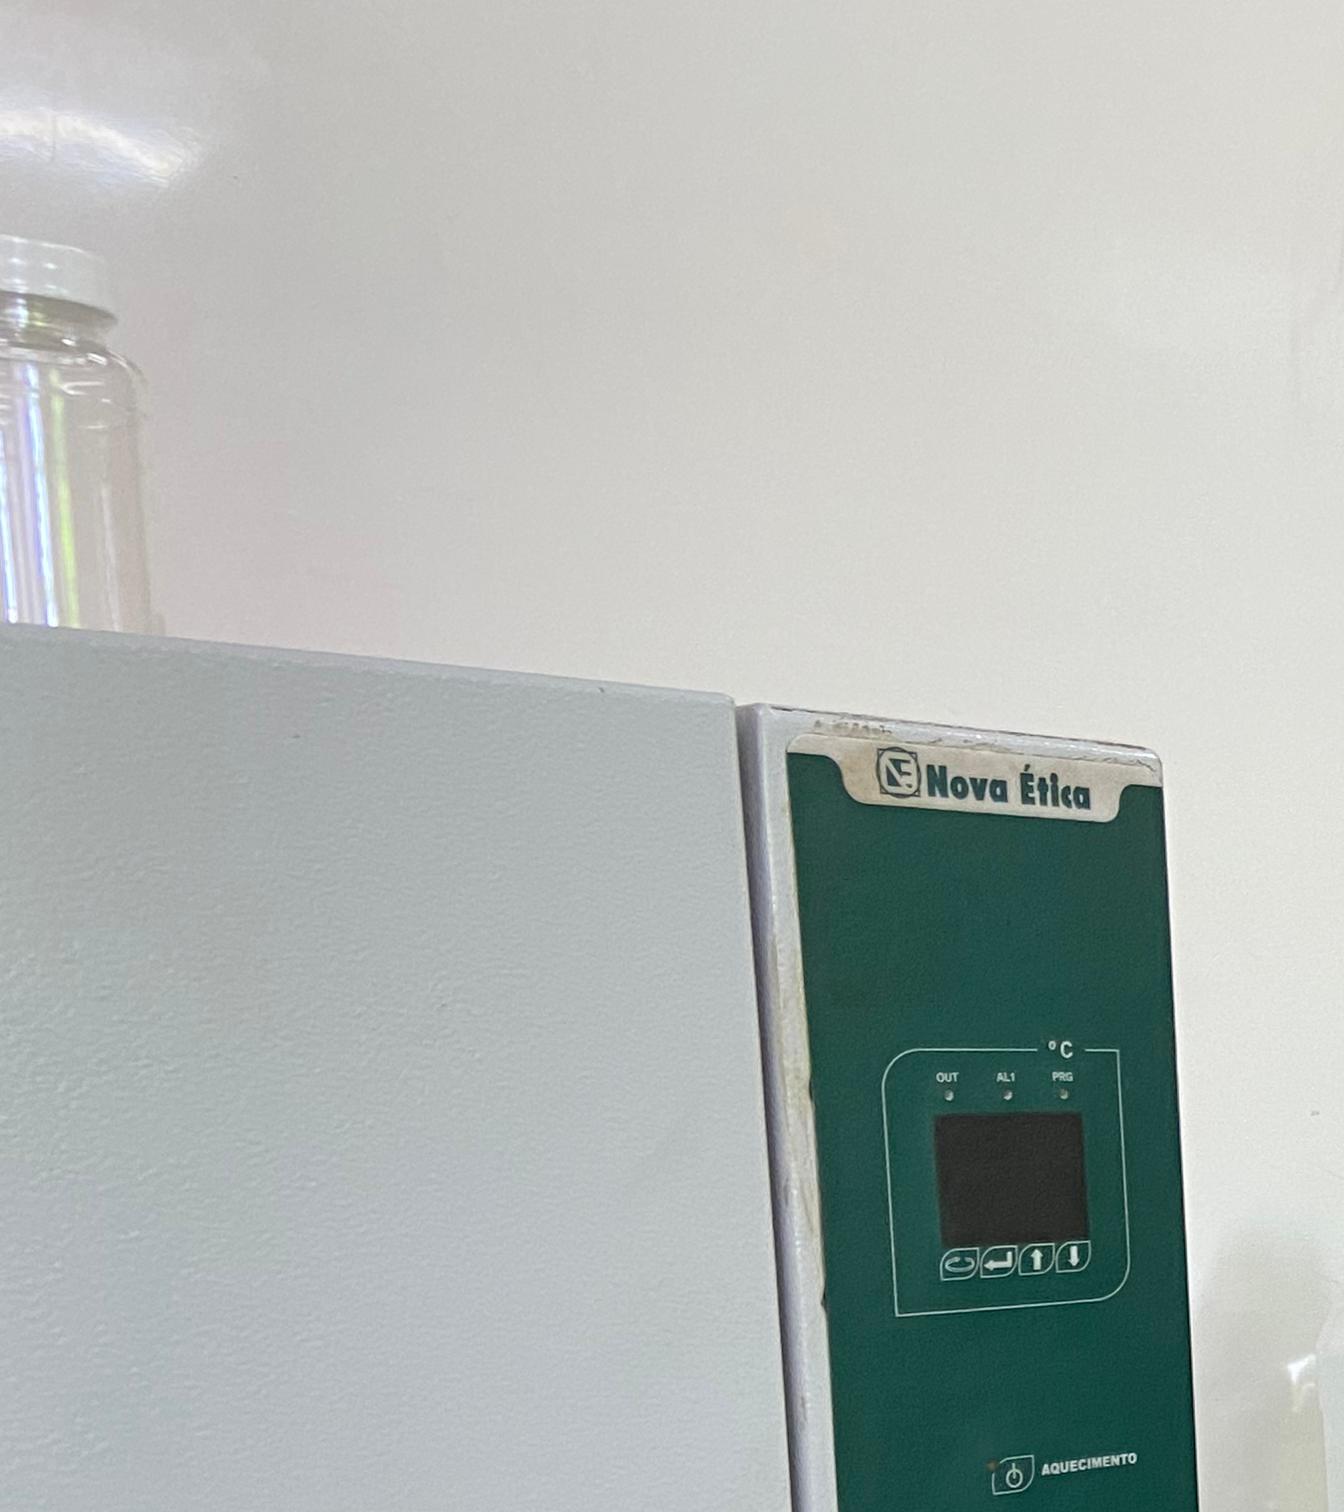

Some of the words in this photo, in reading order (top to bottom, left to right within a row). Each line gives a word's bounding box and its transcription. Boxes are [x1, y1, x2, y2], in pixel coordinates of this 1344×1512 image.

[926, 764, 1008, 803] Nova
[1019, 764, 1091, 810] Ética
[936, 1071, 959, 1083] OUT
[1052, 1071, 1073, 1082] PRG
[1041, 1452, 1138, 1476] AQUECIMENTO
